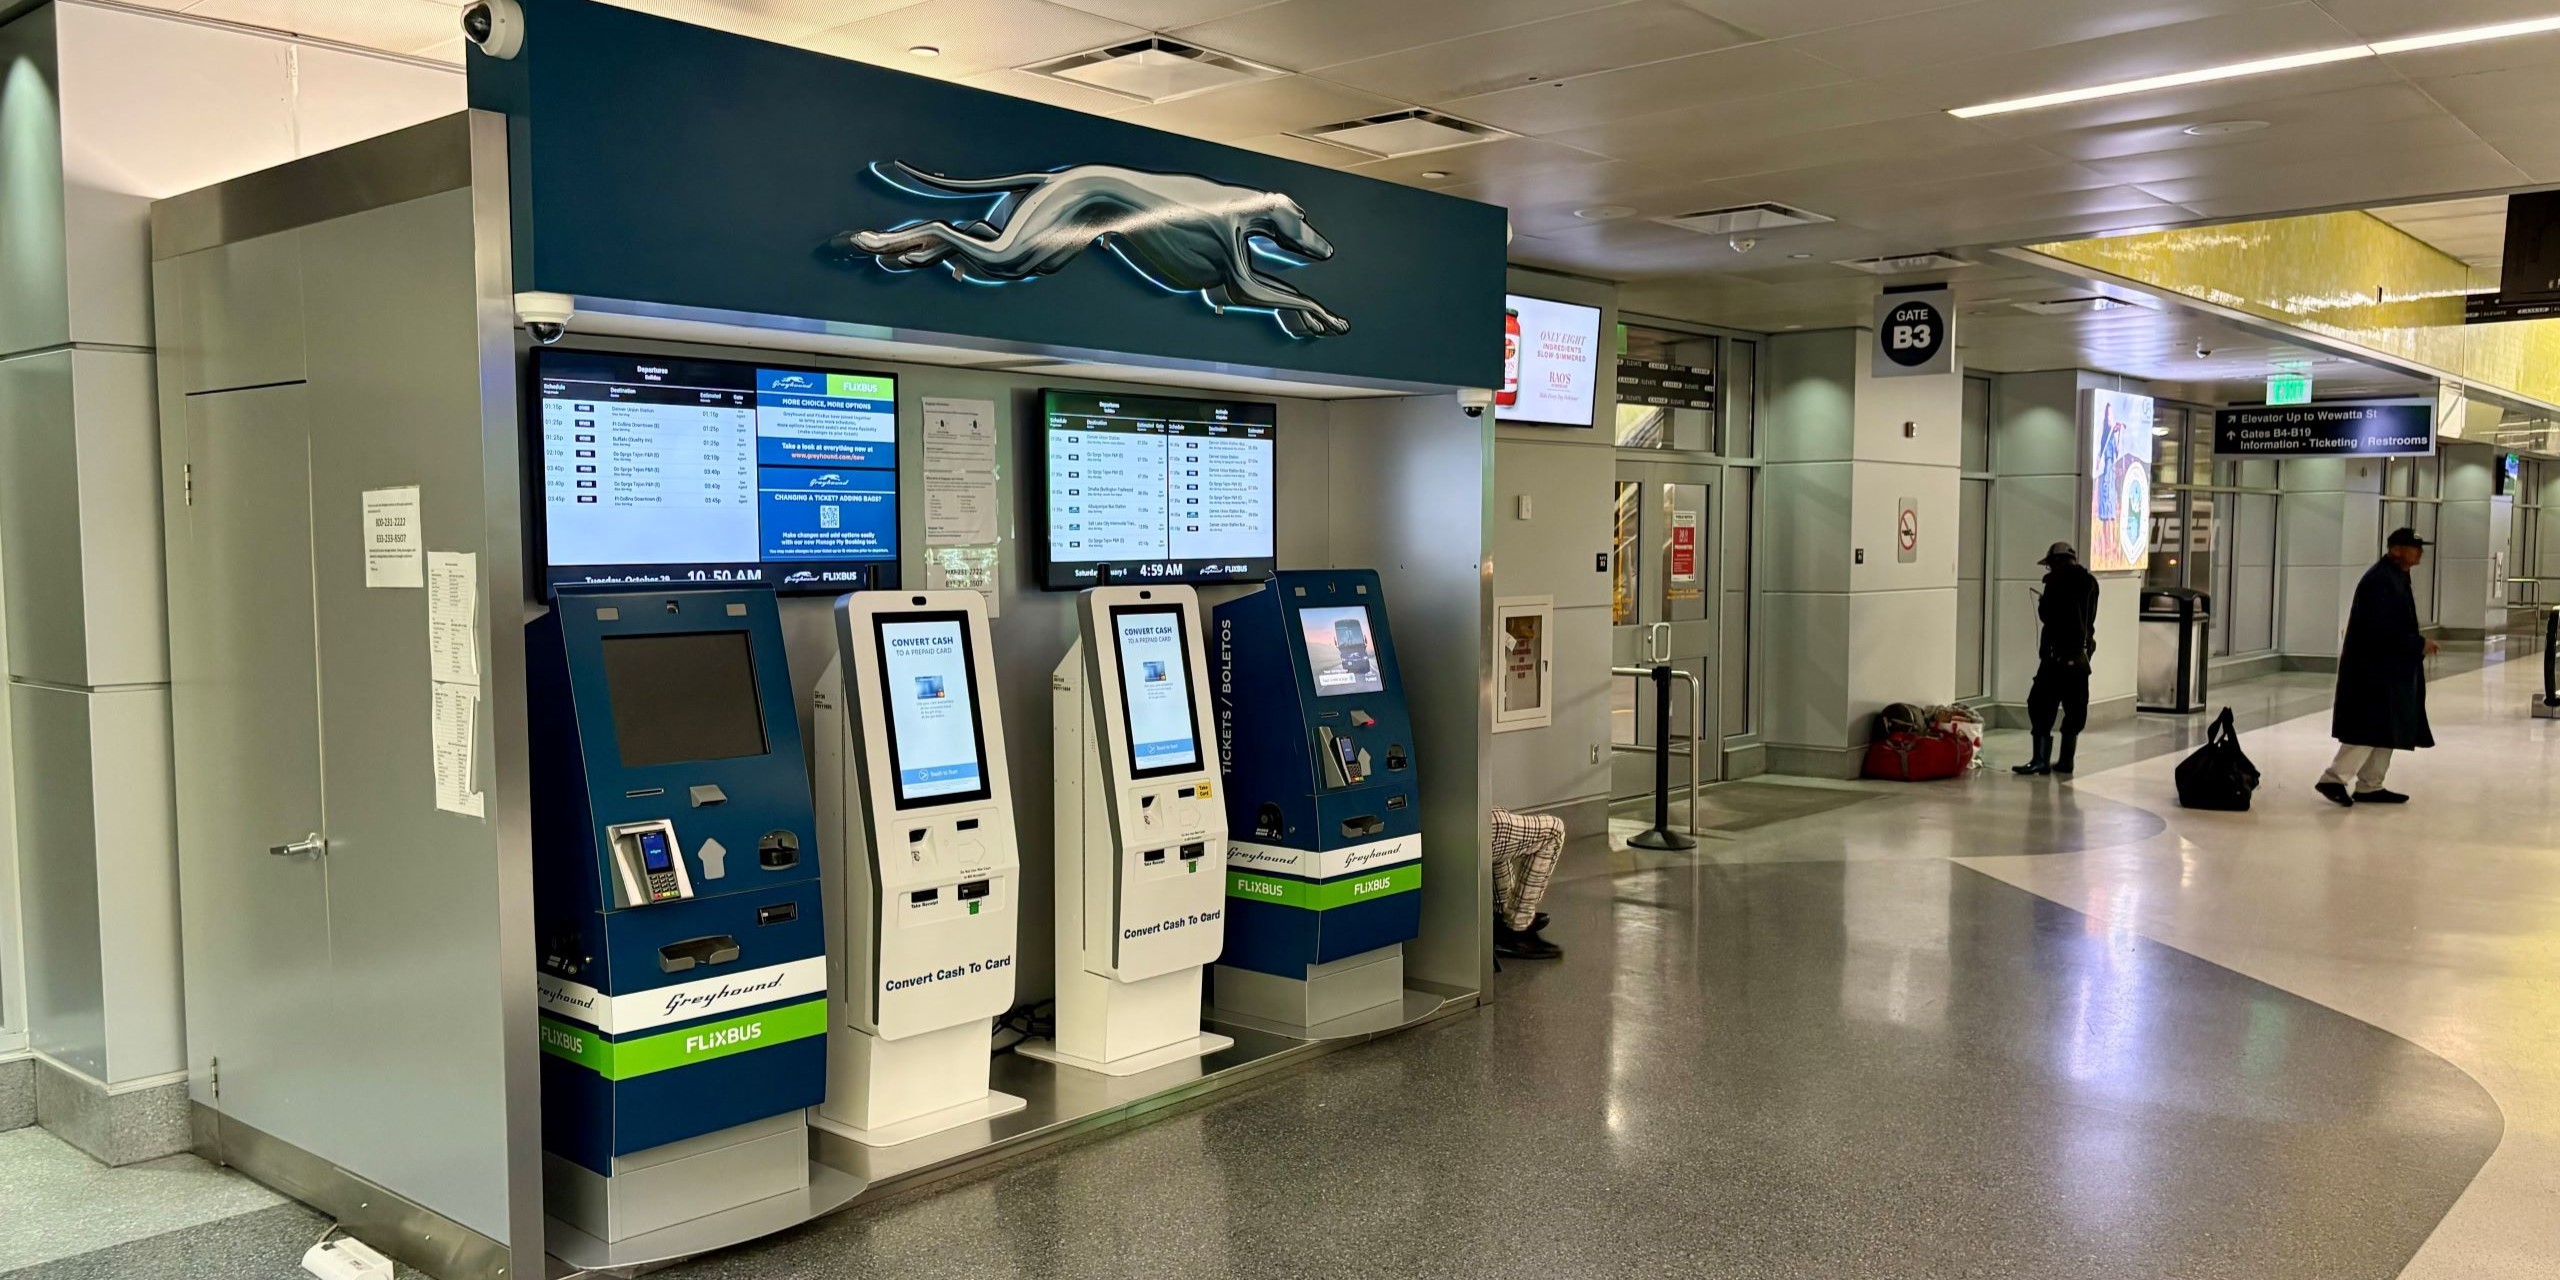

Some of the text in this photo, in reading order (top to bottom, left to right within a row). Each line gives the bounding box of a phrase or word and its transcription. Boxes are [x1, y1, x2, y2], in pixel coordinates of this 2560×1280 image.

[1896, 309, 1929, 321] GATE
[1540, 331, 1587, 346] ONLY EIGHT
[1893, 324, 1931, 349] B3
[1543, 344, 1582, 354] INGREDIENTS
[637, 365, 668, 374] Departures
[1550, 372, 1572, 384] RAO'S
[772, 380, 814, 389] Greyhound
[801, 400, 826, 408] CHOICE,
[845, 402, 871, 410] OPTIONS
[2241, 409, 2378, 424] Elevator Up to Wewatta St
[2240, 428, 2311, 439] Gates B4-B19
[824, 444, 853, 453] everything
[2240, 440, 2299, 450] Information
[2309, 438, 2358, 448] Ticketing
[2367, 436, 2428, 446] Restrooms
[791, 453, 865, 461] www.greyhound.com/new
[810, 479, 849, 487] Greyhound
[736, 570, 762, 580] AM
[1140, 564, 1183, 576] 4:59 AM
[784, 574, 820, 584] Greyhound
[1124, 627, 1154, 636] CONVERT
[891, 636, 954, 647] CONVERT CASH
[1222, 619, 1232, 694] BOLETOS
[1222, 712, 1232, 775] TICKETS
[1227, 846, 1298, 865] Greyhound
[1344, 844, 1402, 868] Greyhound
[1124, 909, 1220, 939] Convert Cash To Card
[886, 955, 1011, 991] Convert Cash To Card
[538, 986, 594, 1009] reyhound
[663, 973, 784, 1016] Greyhound
[686, 1022, 762, 1054] FLiXBUS
